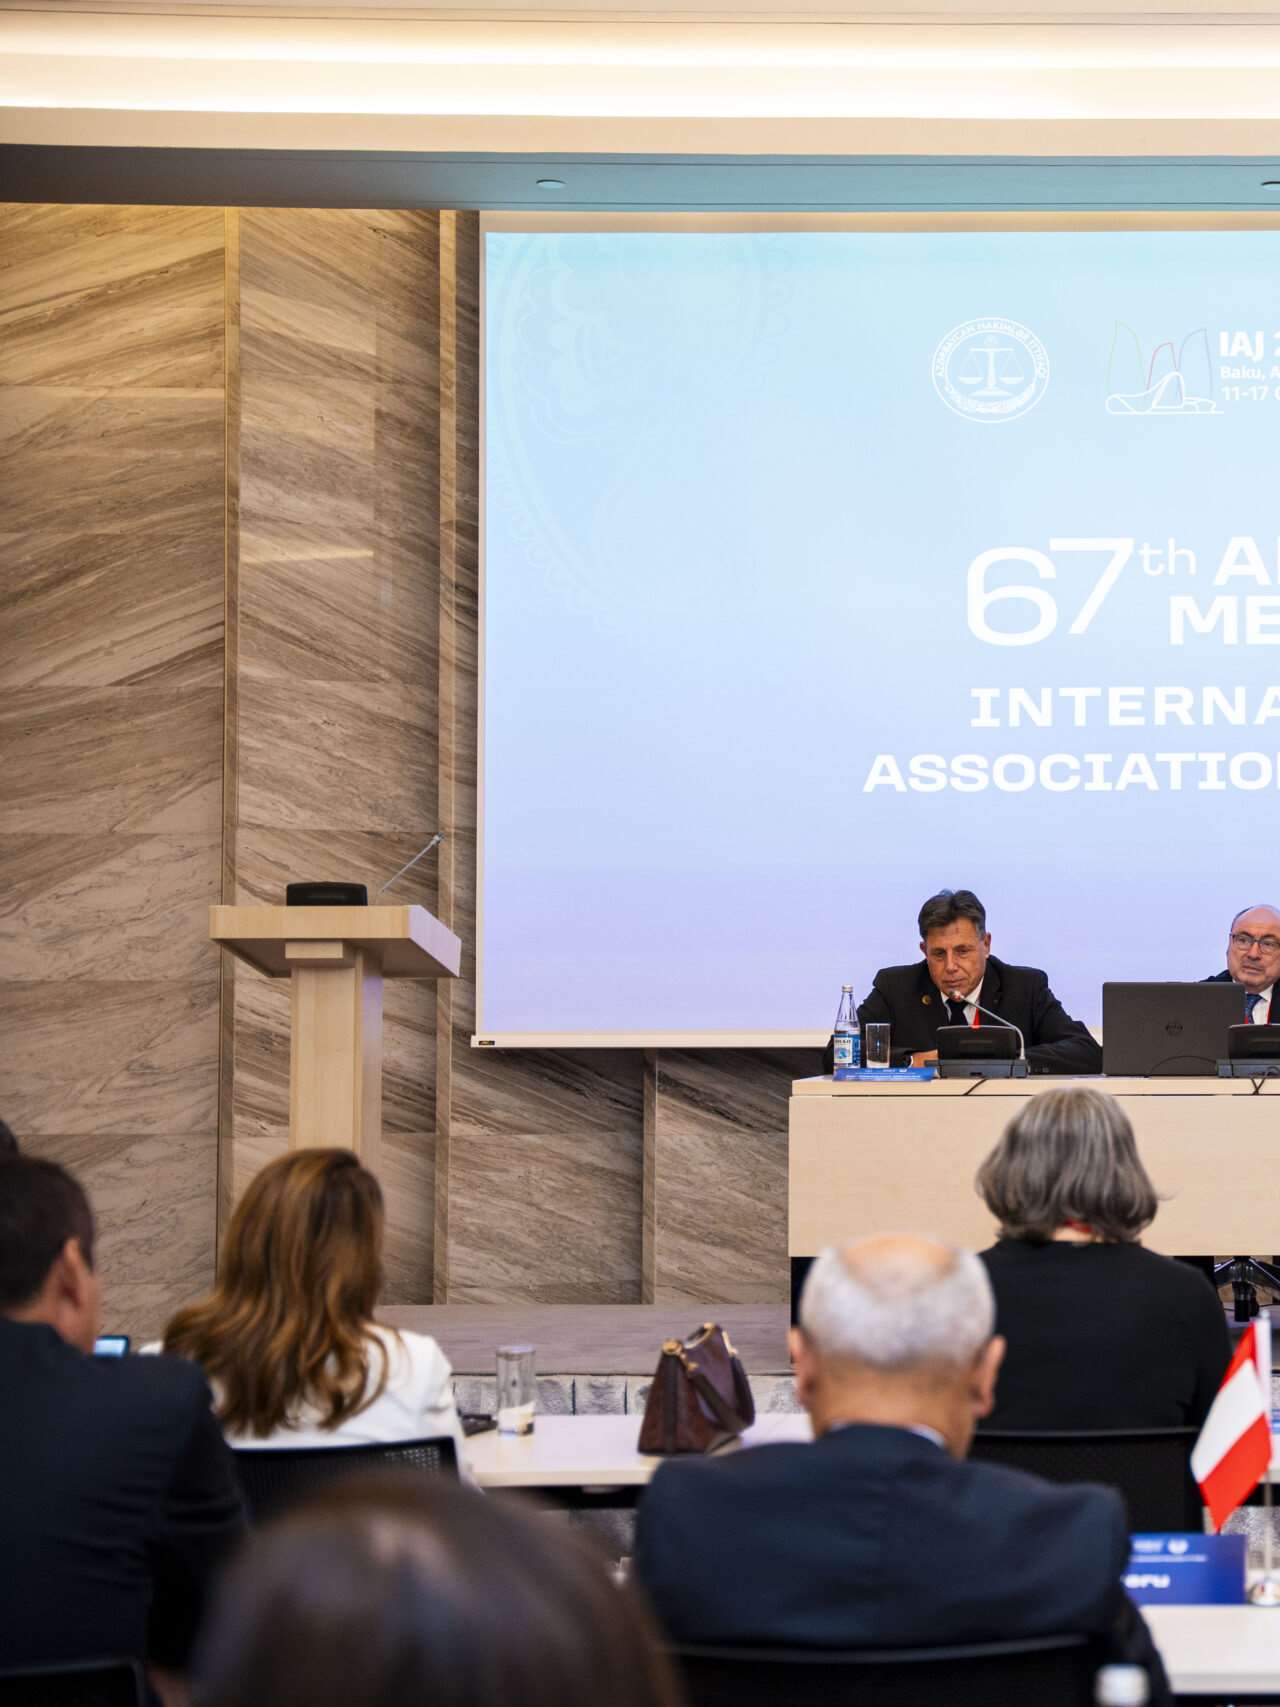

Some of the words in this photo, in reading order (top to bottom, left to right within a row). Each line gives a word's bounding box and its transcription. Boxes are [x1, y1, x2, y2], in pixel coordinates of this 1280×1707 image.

[1219, 331, 1265, 362] IAJ
[1220, 365, 1266, 381] Baku,
[1221, 385, 1269, 401] 11-17
[1121, 1572, 1172, 1590] eru
